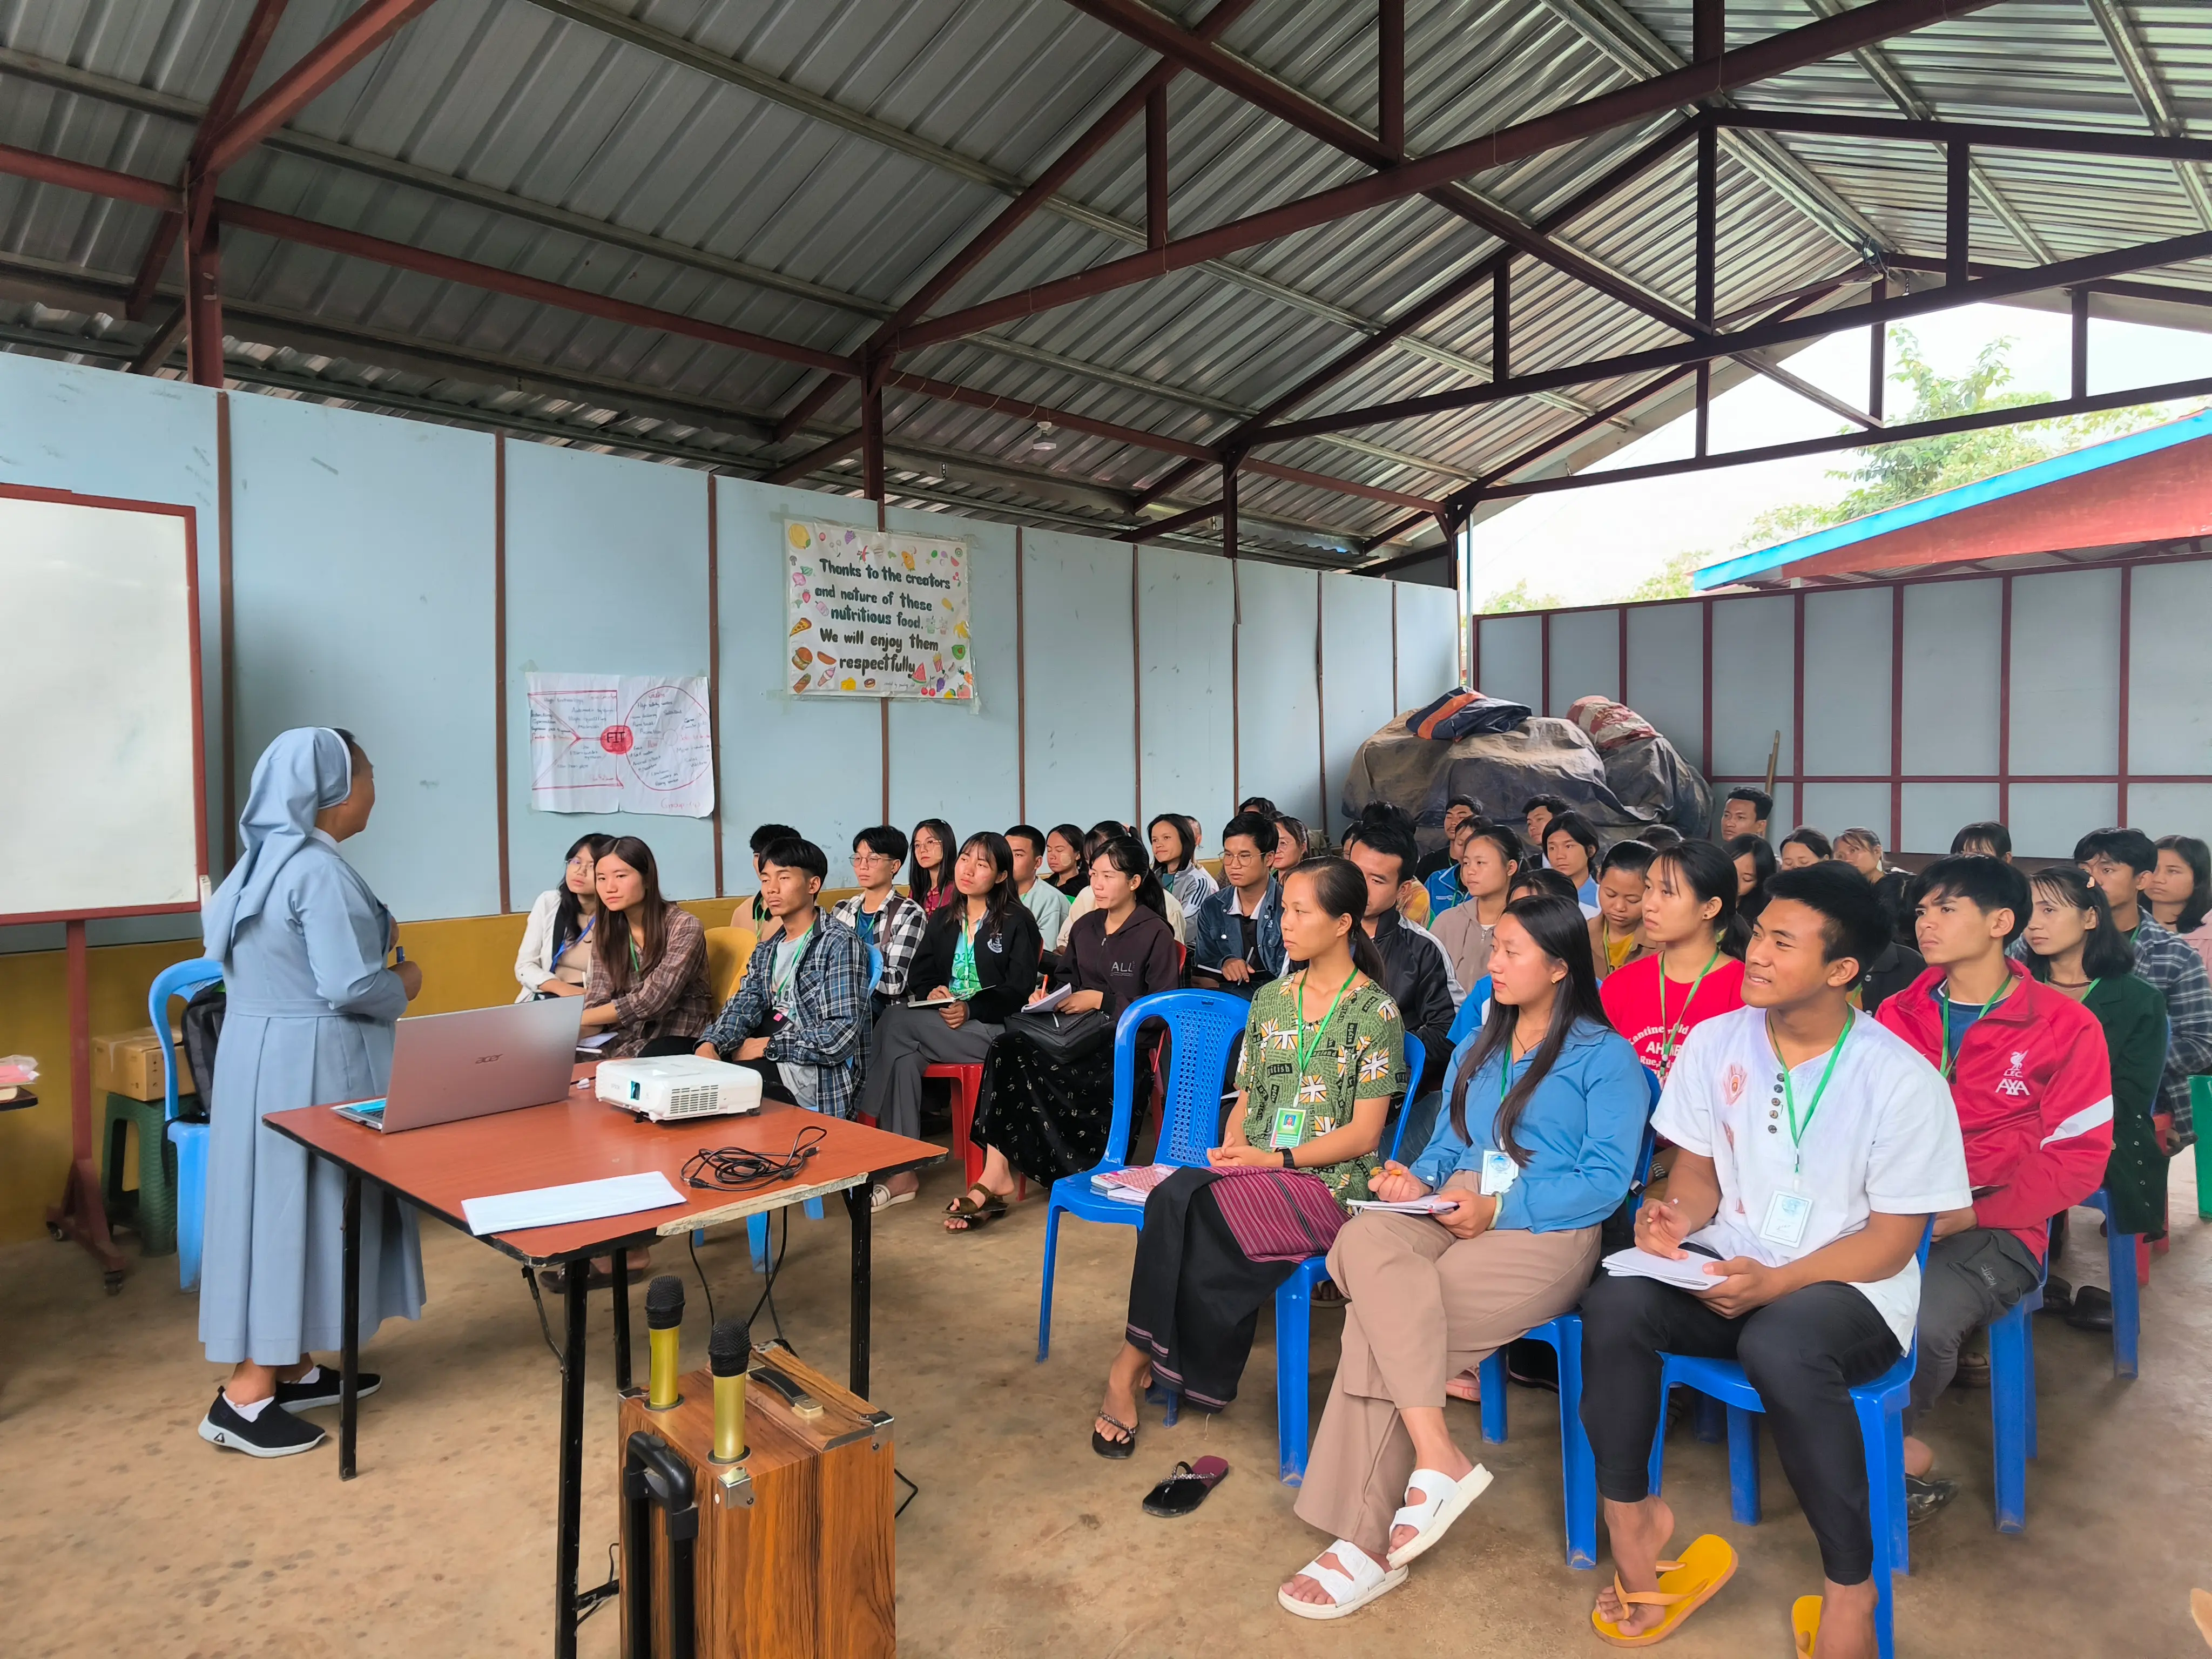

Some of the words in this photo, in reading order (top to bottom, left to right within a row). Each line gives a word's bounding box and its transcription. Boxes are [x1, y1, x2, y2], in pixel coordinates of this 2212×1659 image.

[820, 558, 861, 577] Thanks
[866, 564, 879, 579] to
[881, 568, 902, 583] the
[906, 573, 950, 590] creators
[814, 584, 835, 598] and
[841, 586, 878, 603] nature
[882, 591, 894, 605] of
[900, 593, 932, 612] these
[831, 605, 892, 625] nutritious
[896, 612, 923, 629] food.
[820, 628, 838, 643] We
[844, 630, 864, 645] will
[871, 633, 902, 653] enjoy
[909, 634, 939, 651] them
[839, 654, 915, 678] respectfully
[1347, 1024, 1355, 1043] style
[475, 1054, 503, 1064] acer
[1995, 1078, 2031, 1096] AXA
